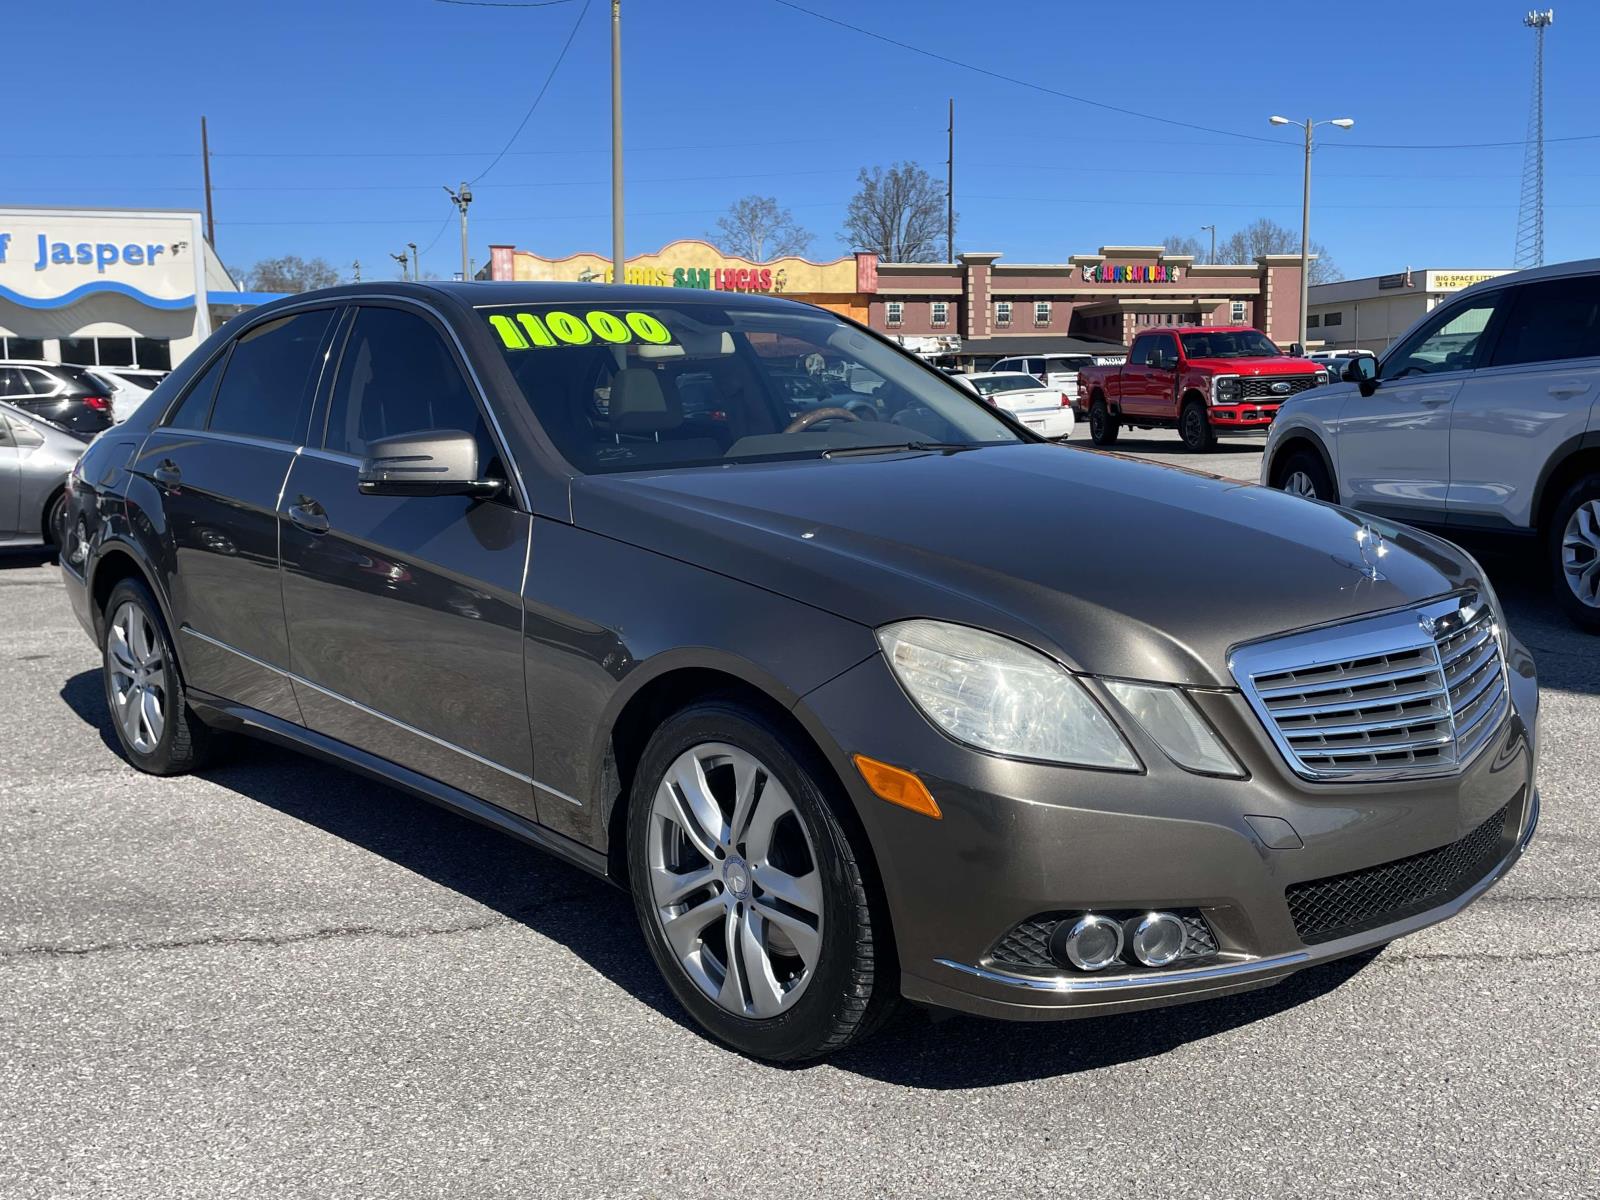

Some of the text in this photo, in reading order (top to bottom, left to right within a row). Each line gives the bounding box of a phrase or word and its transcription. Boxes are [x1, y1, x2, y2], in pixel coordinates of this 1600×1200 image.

[34, 233, 165, 274] Jasper
[673, 267, 711, 289] SAN
[714, 268, 773, 293] LUCAS
[1096, 264, 1171, 282] CABOS SAN LUCAS
[489, 311, 671, 349] 11000
